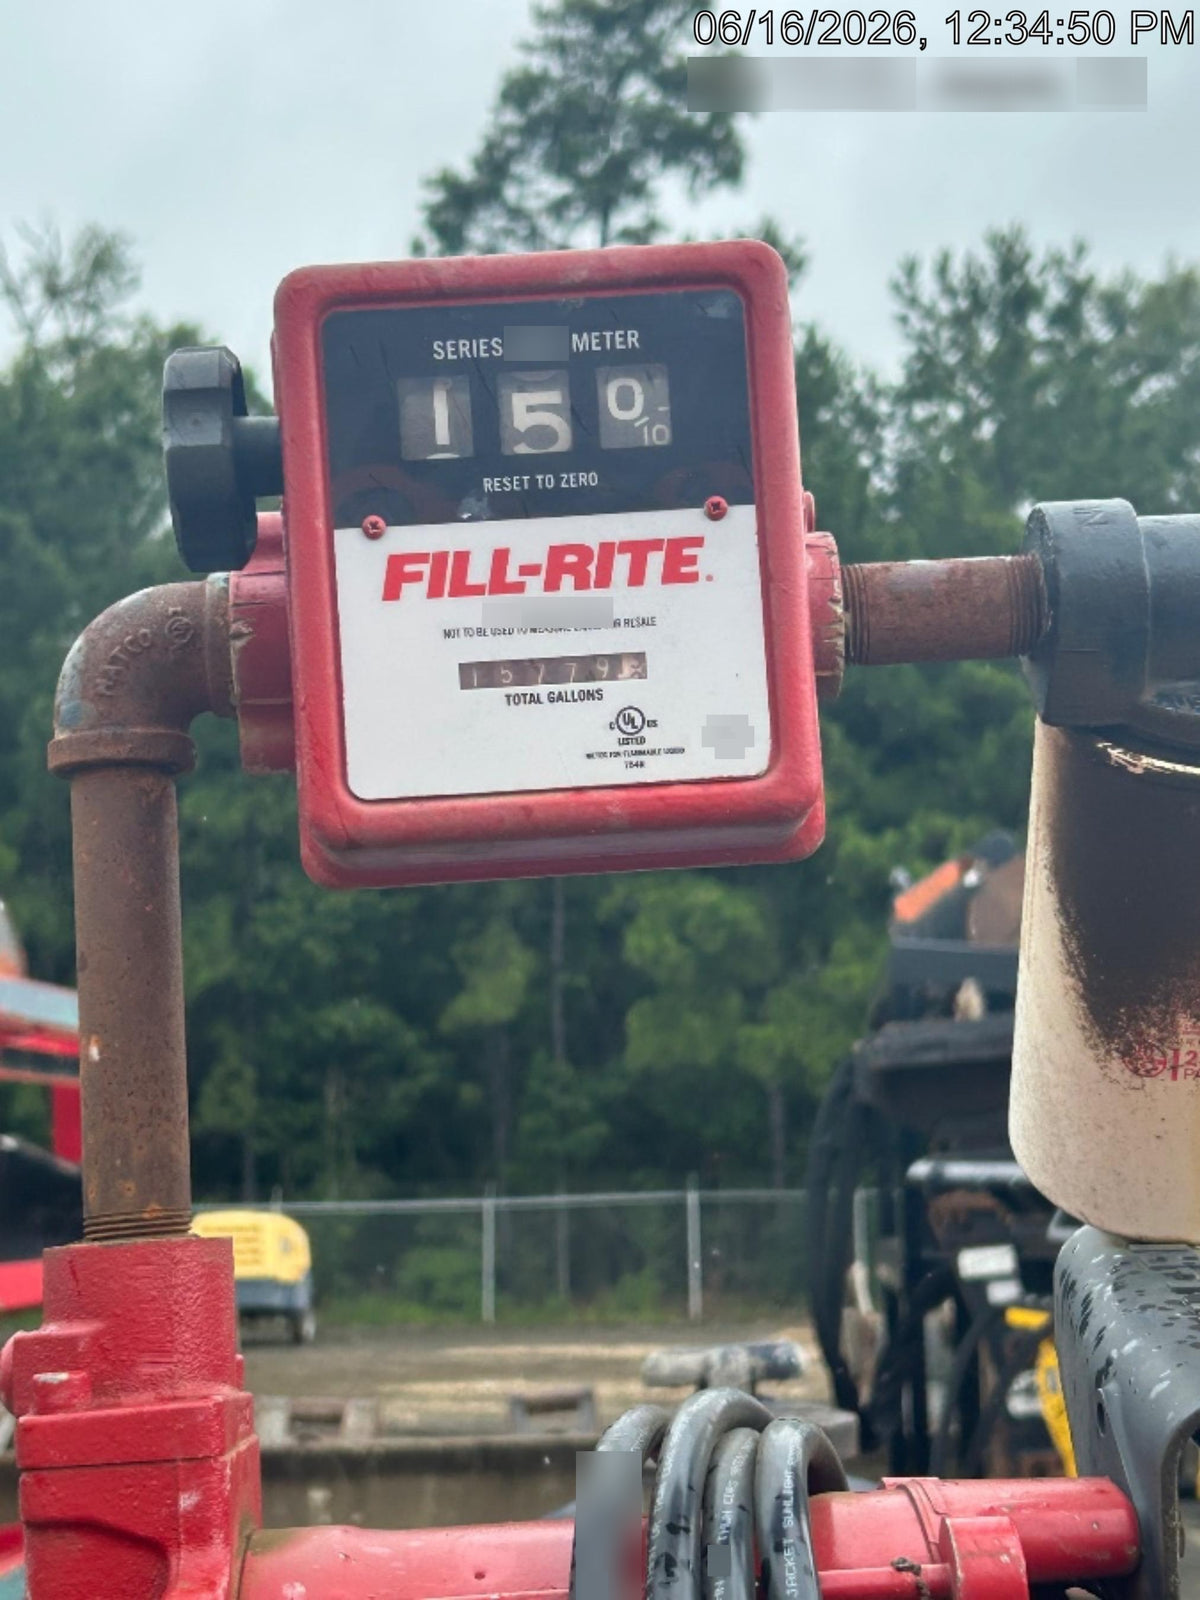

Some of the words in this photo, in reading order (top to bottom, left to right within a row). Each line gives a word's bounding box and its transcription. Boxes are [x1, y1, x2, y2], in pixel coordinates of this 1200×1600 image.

[432, 337, 504, 360] SERIES
[571, 330, 640, 353] METER
[482, 475, 530, 493] RESET
[535, 473, 555, 490] TO
[560, 471, 599, 488] ZERO
[381, 536, 706, 601] FILL-RITE
[475, 626, 489, 637] BE
[505, 691, 544, 707] TOTAL
[547, 688, 604, 704] GALLONS
[781, 1470, 795, 1529] SUNLIGHT
[783, 1537, 800, 1598] JACKET
